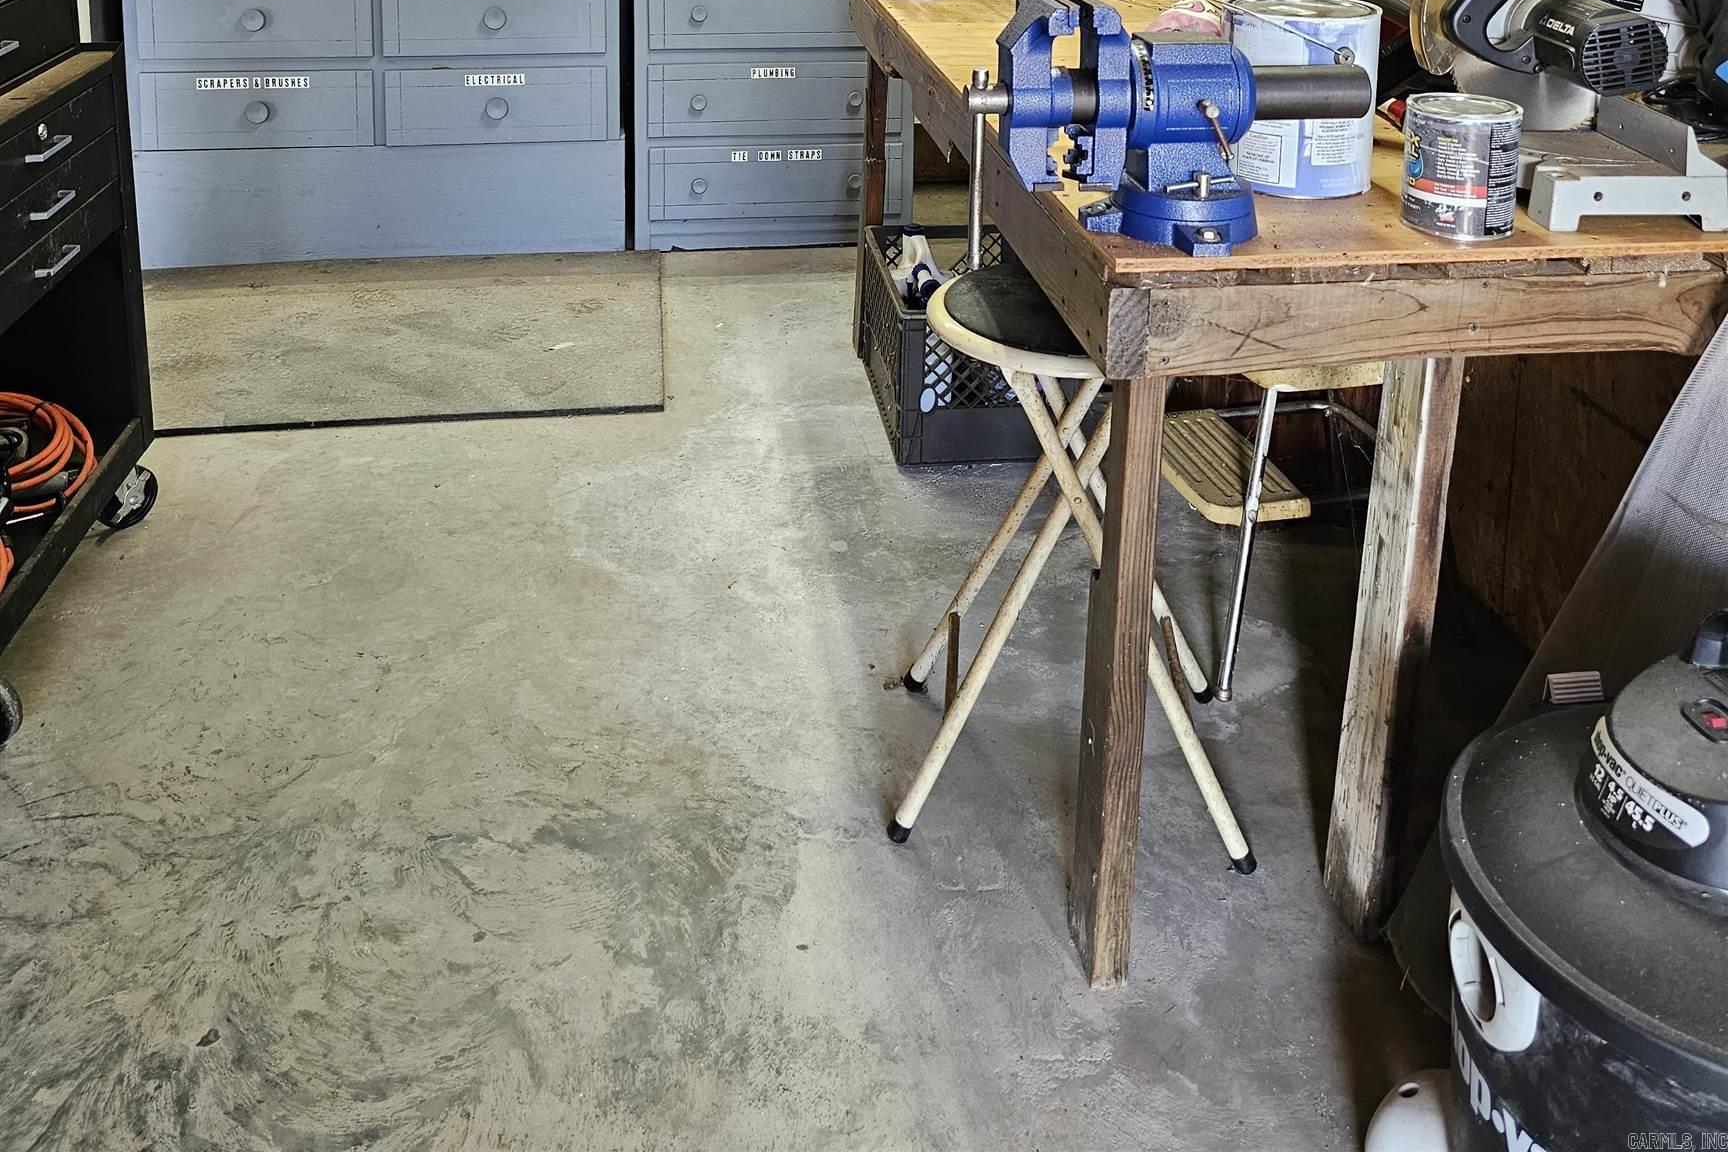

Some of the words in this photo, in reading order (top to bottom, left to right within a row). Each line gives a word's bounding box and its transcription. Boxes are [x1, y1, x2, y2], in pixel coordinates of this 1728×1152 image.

[1545, 17, 1576, 37] DELTA
[751, 68, 795, 78] PLUMBING
[197, 78, 249, 89] SCRAPERS
[253, 77, 261, 88] &
[265, 77, 309, 88] BRUSHES
[465, 74, 525, 86] ELECTRICAL
[732, 151, 748, 161] TIE
[758, 151, 781, 160] DOWN
[788, 150, 822, 160] STRAPS
